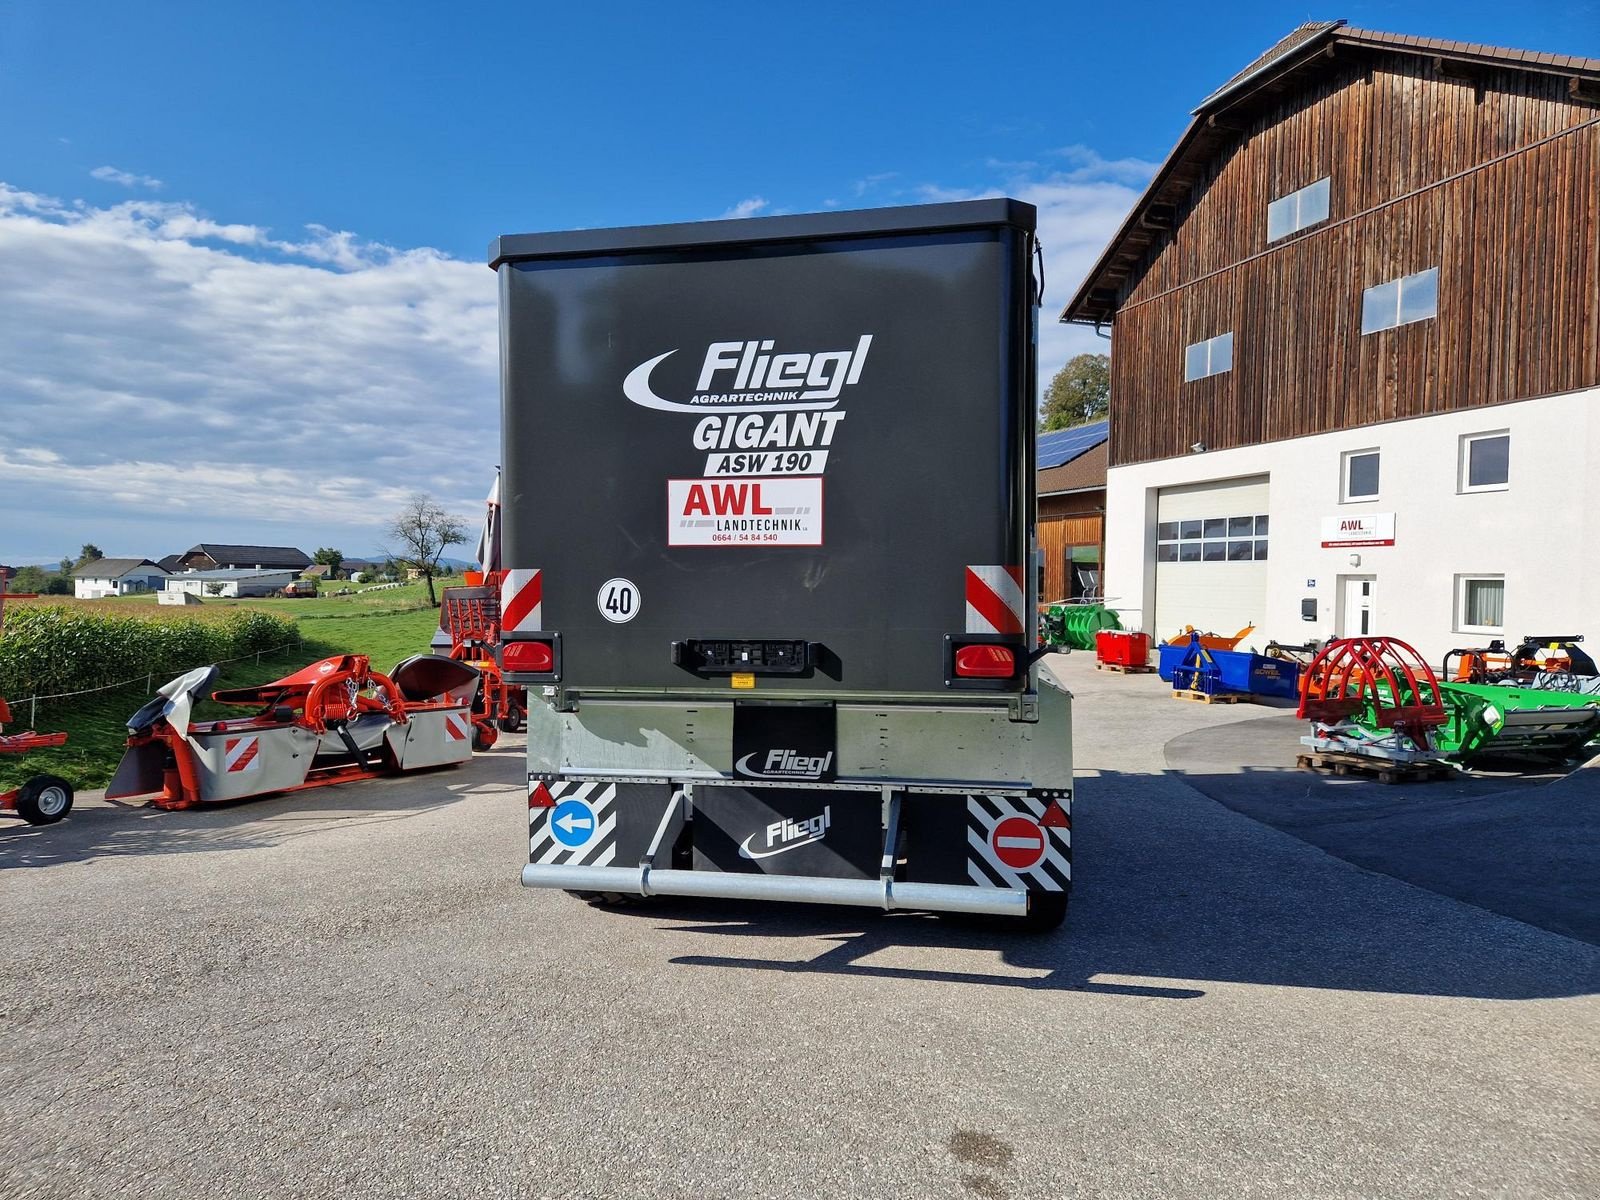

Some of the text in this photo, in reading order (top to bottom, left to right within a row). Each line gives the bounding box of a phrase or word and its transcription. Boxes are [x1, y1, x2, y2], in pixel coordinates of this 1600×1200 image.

[696, 334, 873, 400] Fliegl
[690, 391, 799, 404] AGRARTECHNIK
[692, 410, 846, 450] GIGANT
[716, 452, 812, 473] ASW 190
[683, 483, 772, 516] AWL
[712, 534, 732, 542] 0664
[739, 534, 749, 542] 54
[751, 534, 761, 542] 84
[763, 533, 778, 541] 540
[716, 519, 801, 532] LANDTECHNIK
[1340, 519, 1364, 531] AWL
[605, 586, 632, 615] 40
[764, 749, 833, 776] Fliegl
[766, 805, 831, 848] Fliegl
